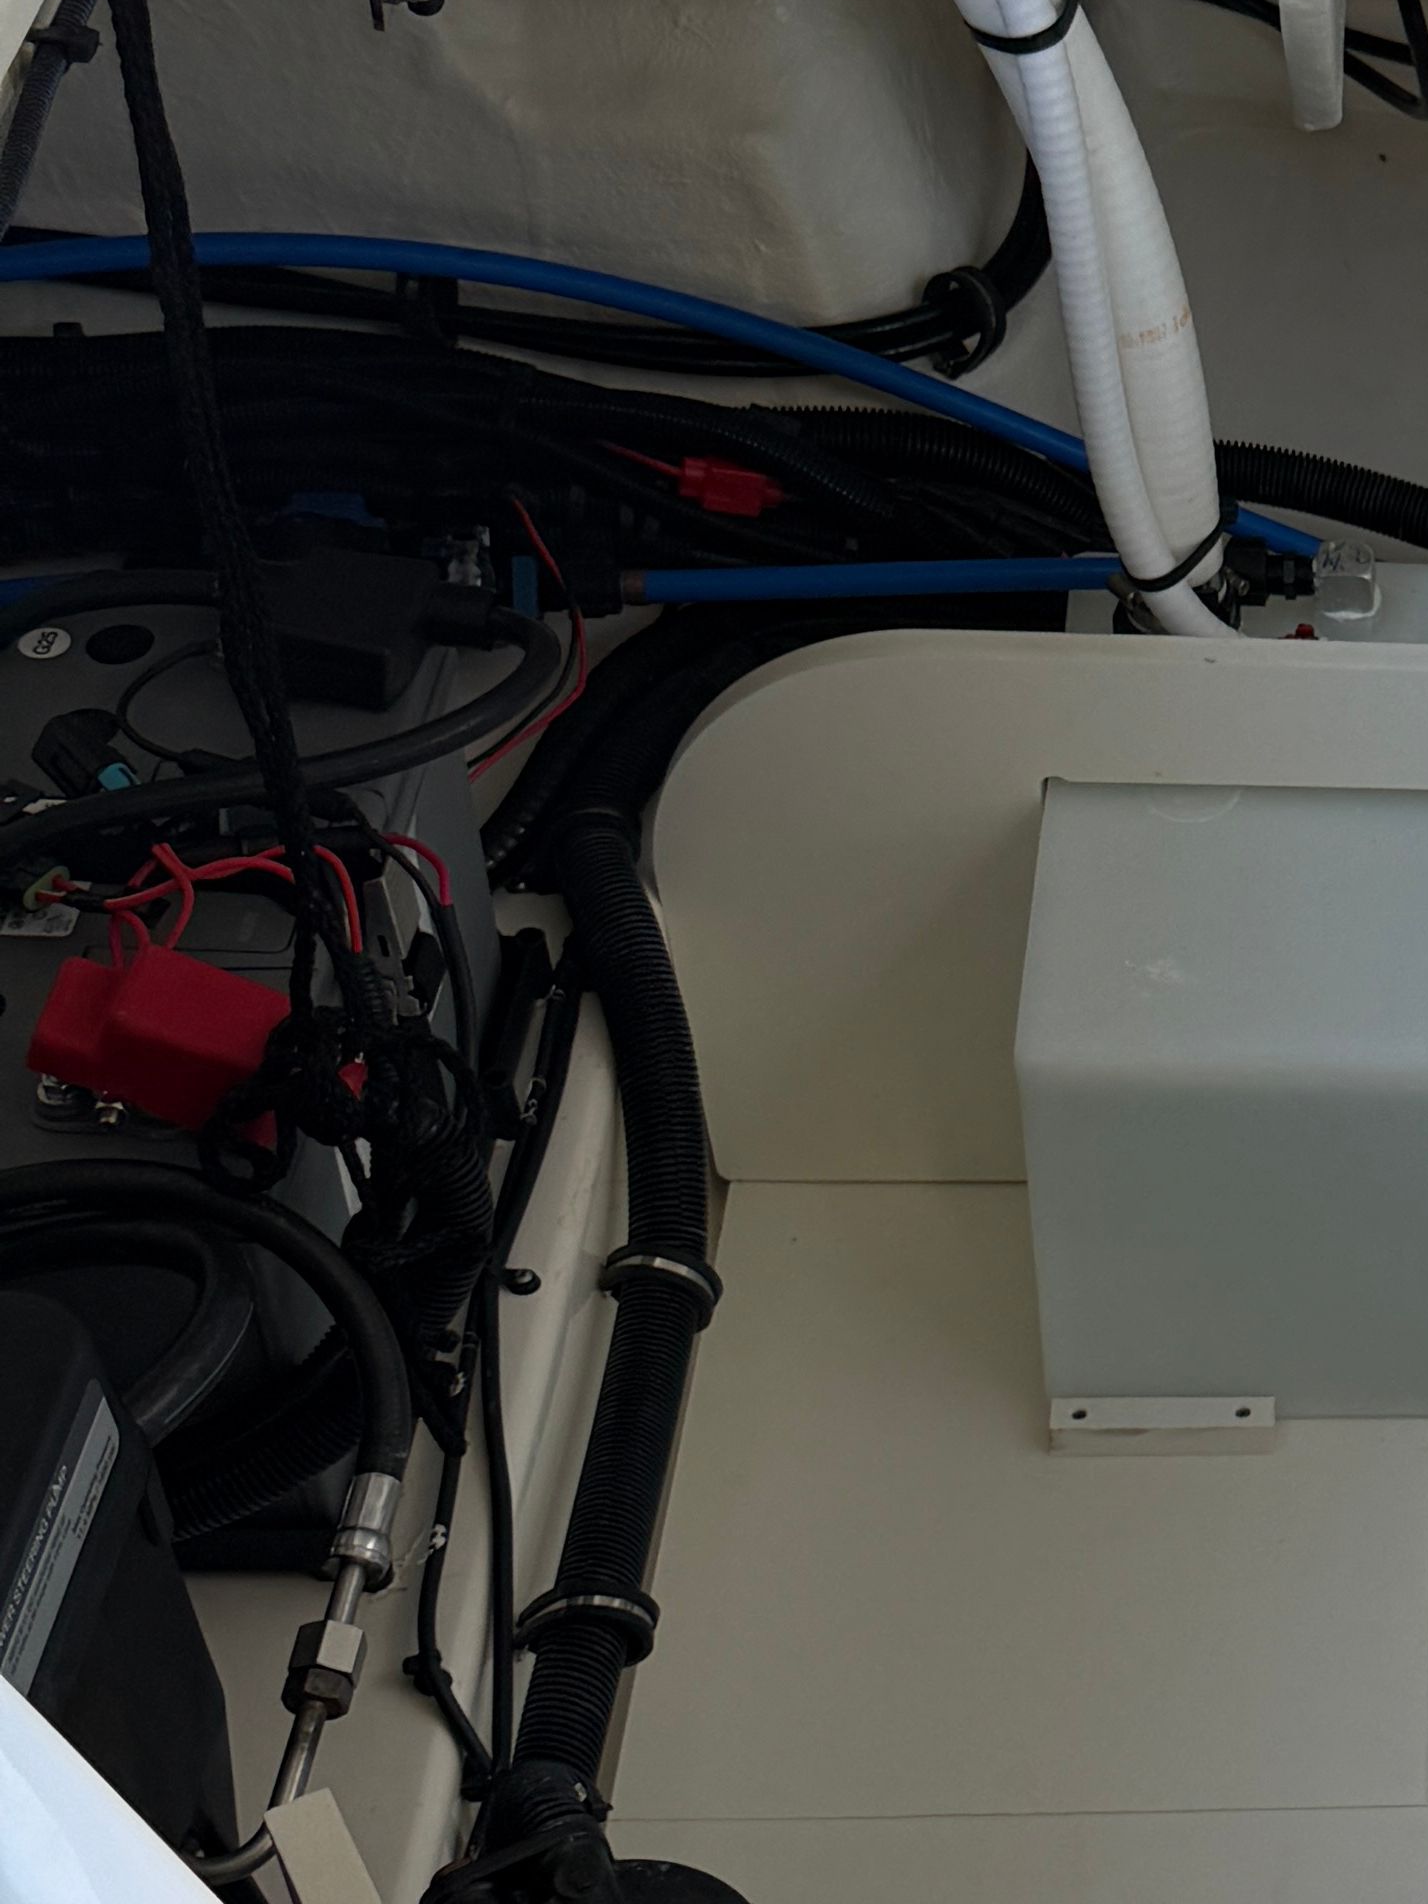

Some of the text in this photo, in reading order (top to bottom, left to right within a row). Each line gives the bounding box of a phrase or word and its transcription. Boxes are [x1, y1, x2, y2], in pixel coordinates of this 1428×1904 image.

[32, 631, 58, 655] G25
[13, 1518, 48, 1605] STEERING
[46, 1464, 67, 1517] PUMP
